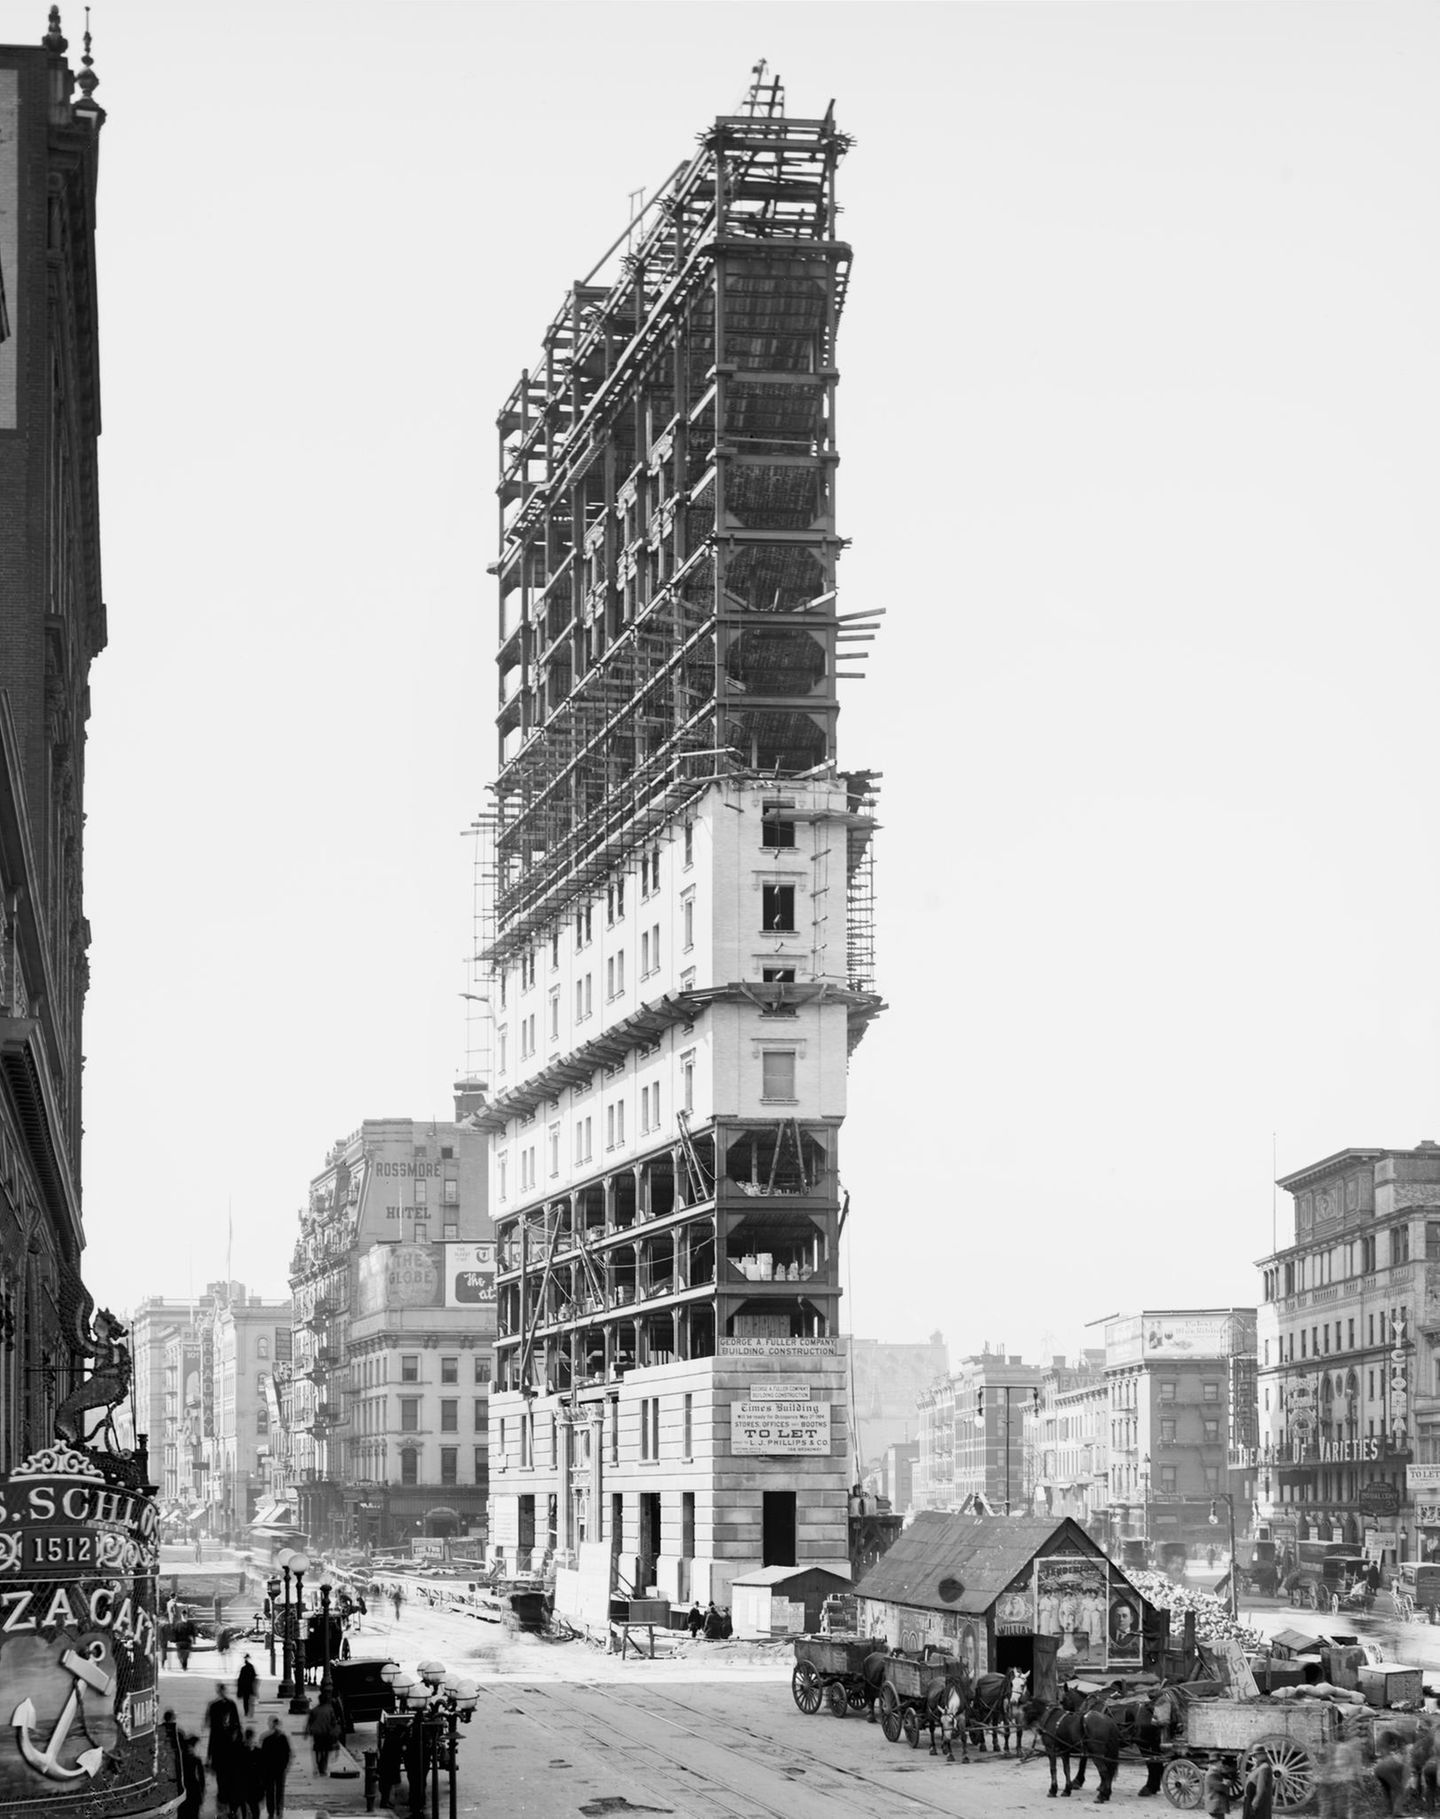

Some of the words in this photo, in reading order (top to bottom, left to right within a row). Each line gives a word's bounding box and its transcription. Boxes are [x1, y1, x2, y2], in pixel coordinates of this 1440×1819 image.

[376, 1162, 441, 1177] ROSSMORE
[386, 1206, 432, 1219] HOTEL
[389, 1271, 433, 1285] GLOBE
[463, 1272, 486, 1287] The
[720, 1338, 752, 1346] GEORGE
[766, 1338, 797, 1346] FULLER
[800, 1338, 835, 1346] COMPANY
[722, 1347, 765, 1355] BUILDING
[768, 1347, 835, 1355] CONSTRUCTION
[203, 1328, 214, 1434] BROADWAY
[741, 1403, 772, 1412] Times
[775, 1403, 819, 1414] Building
[744, 1429, 770, 1438] TO
[777, 1429, 817, 1438] LET
[1318, 1436, 1379, 1463] VARIETIES
[1410, 1470, 1422, 1478] TO
[1423, 1470, 1440, 1478] LET
[34, 1537, 91, 1562] 1512
